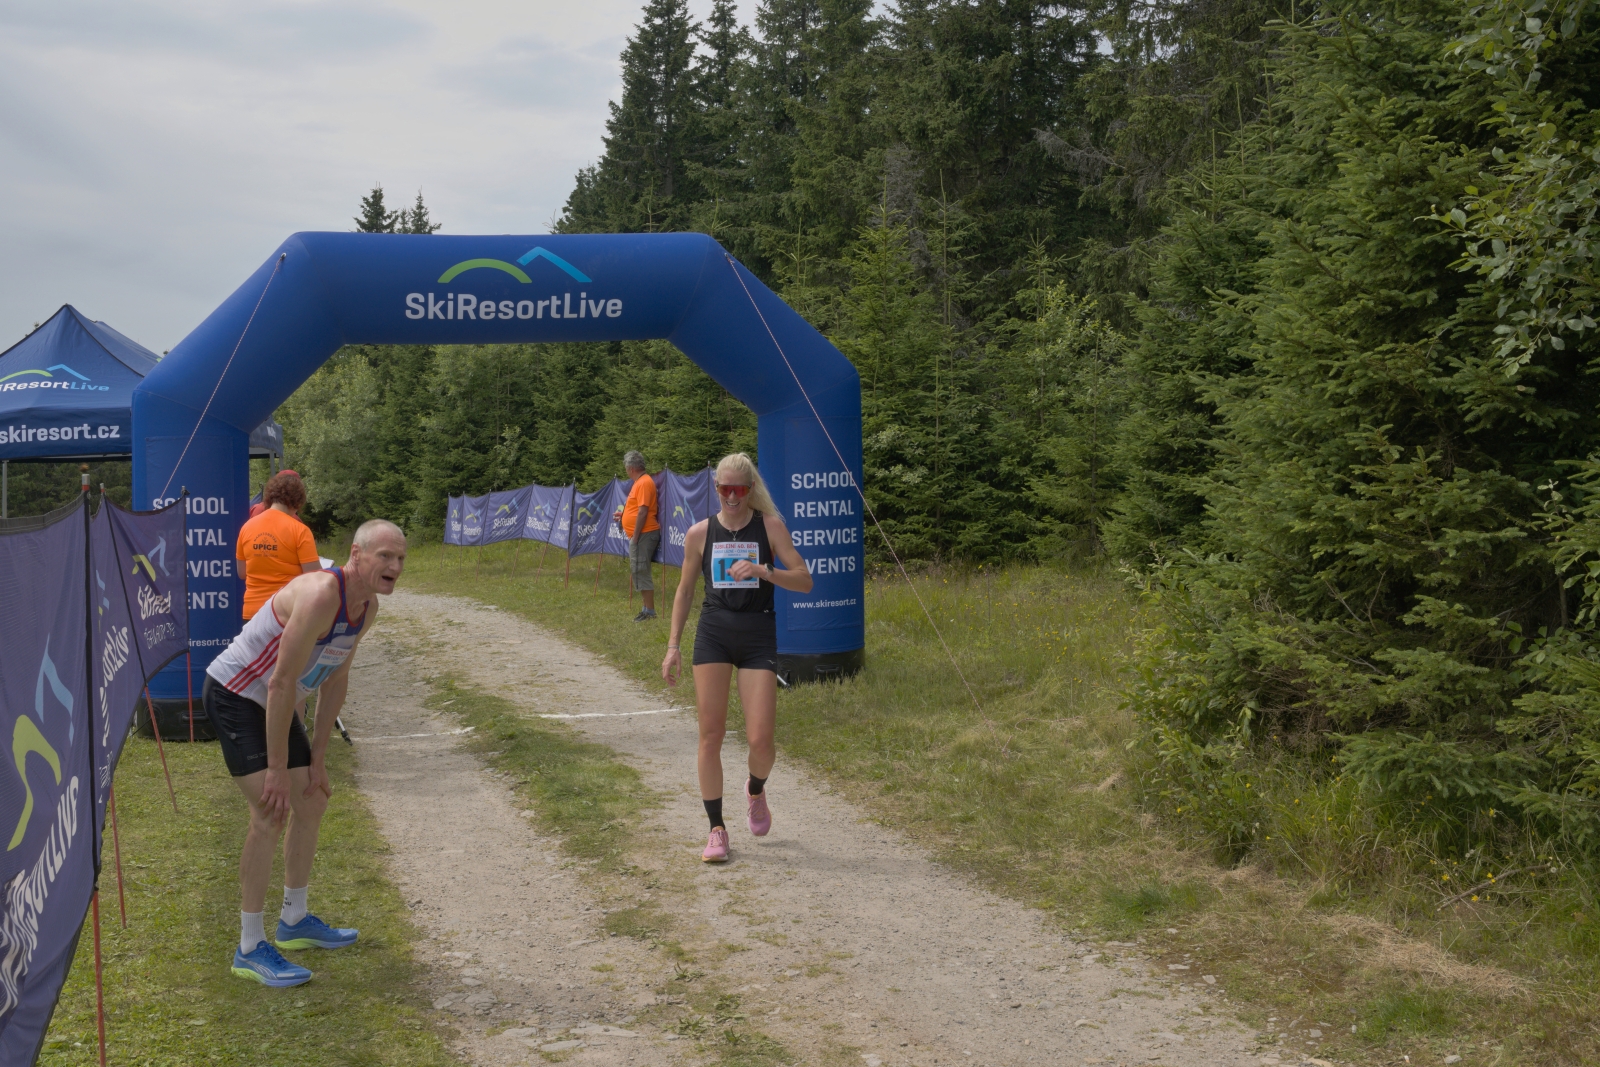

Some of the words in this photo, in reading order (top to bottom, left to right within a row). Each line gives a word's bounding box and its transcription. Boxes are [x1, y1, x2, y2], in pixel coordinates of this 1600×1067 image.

[405, 292, 623, 320] SkiResortLive
[0, 381, 110, 392] iResortLive
[791, 471, 856, 490] SCHOOL
[794, 500, 855, 518] RENTAL
[186, 528, 227, 546] NTAL
[791, 528, 857, 547] SERVICE
[187, 559, 232, 578] VICE
[805, 556, 856, 575] VENTS
[188, 591, 229, 610] NTS
[793, 599, 857, 609] www.skiresort.cz
[188, 638, 231, 647] iresort.cz
